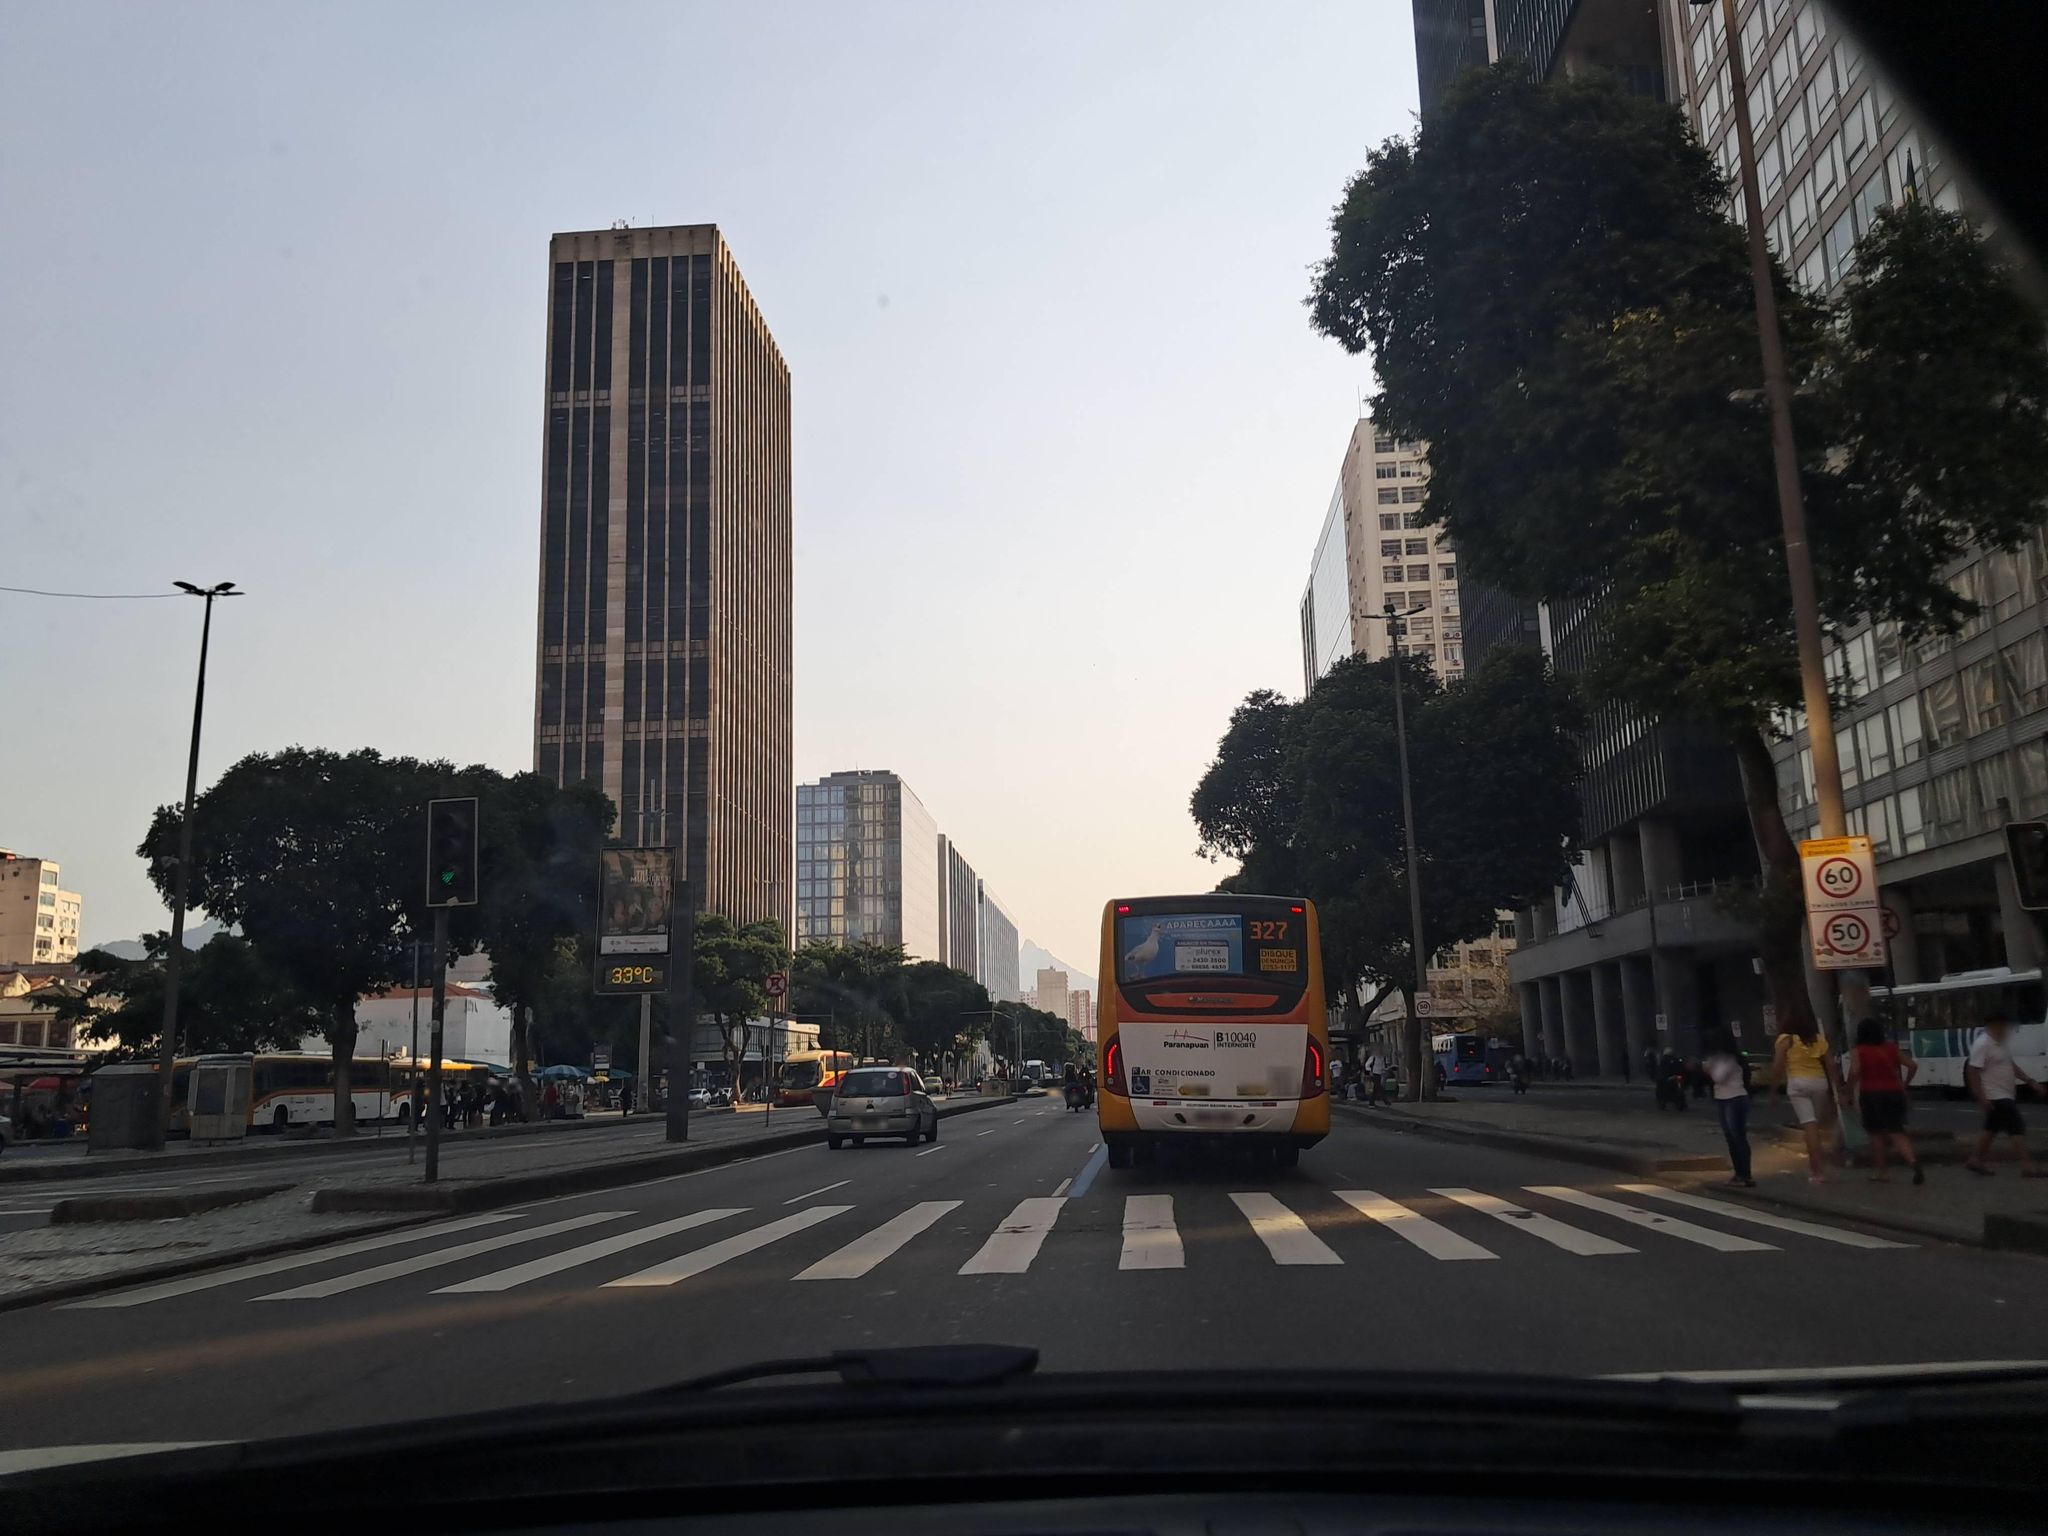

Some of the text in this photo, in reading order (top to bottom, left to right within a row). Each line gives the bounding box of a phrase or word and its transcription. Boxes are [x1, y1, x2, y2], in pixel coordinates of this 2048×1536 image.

[1825, 866, 1853, 885] 60
[1250, 921, 1288, 940] 327
[1831, 923, 1861, 941] 50
[1163, 1041, 1209, 1049] Paranapuan
[1216, 1032, 1256, 1042] B10040
